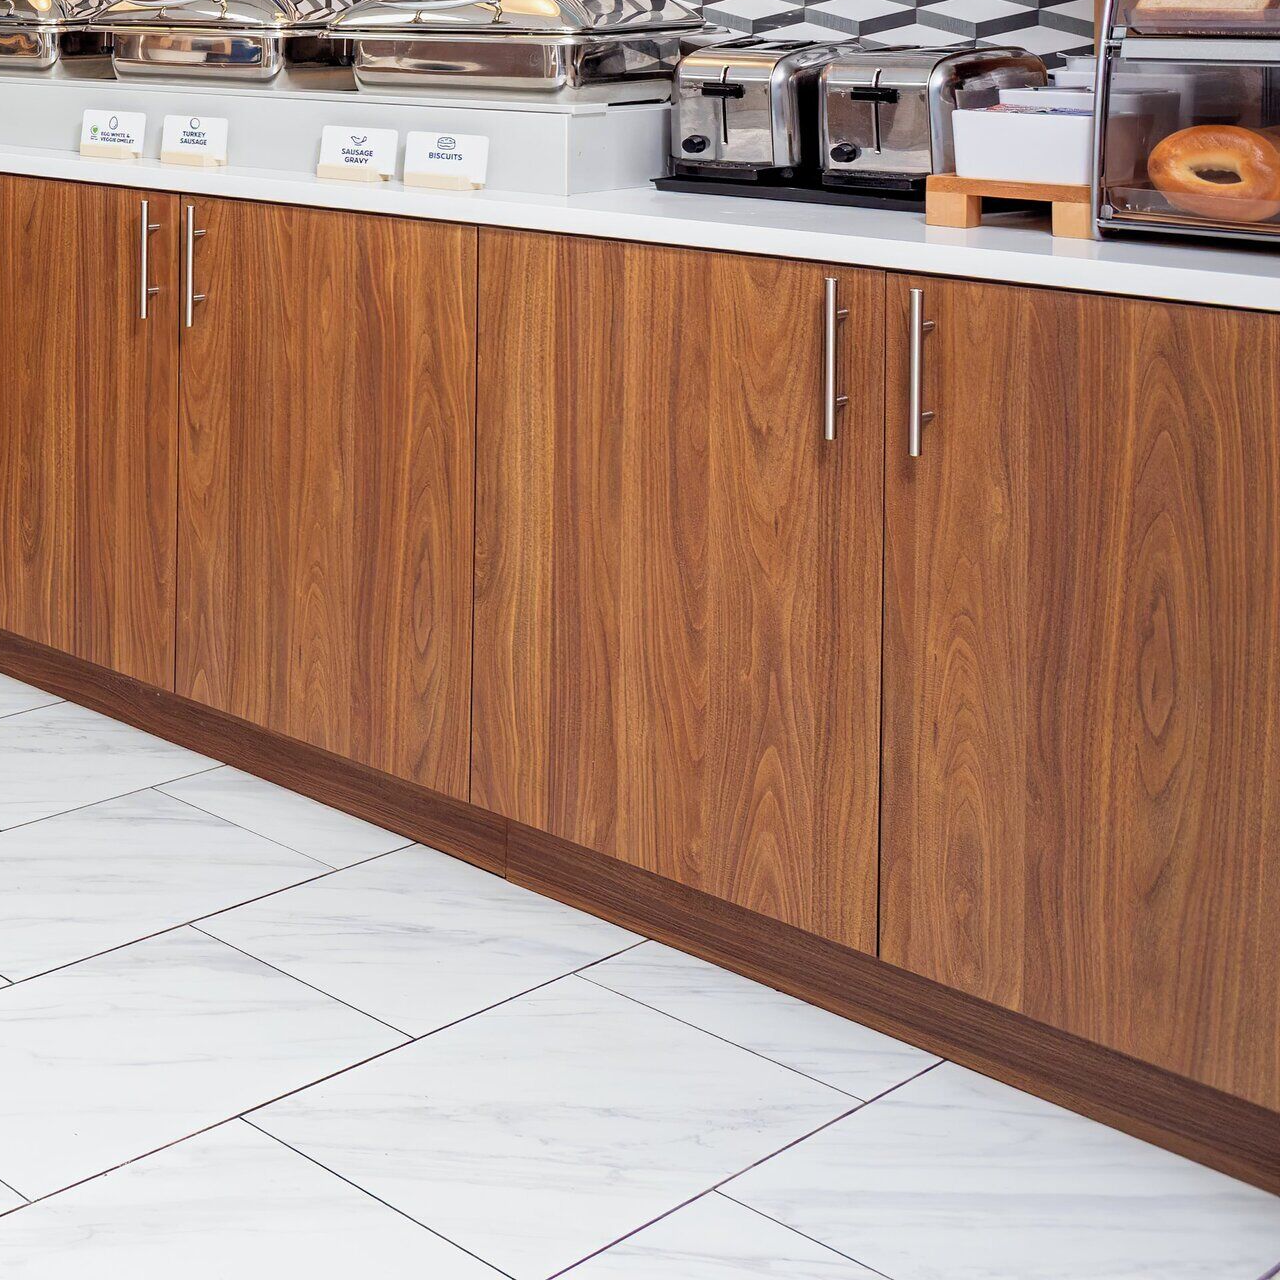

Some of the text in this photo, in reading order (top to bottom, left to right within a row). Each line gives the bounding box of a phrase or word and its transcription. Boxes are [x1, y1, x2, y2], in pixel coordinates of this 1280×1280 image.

[182, 130, 207, 138] TURKEY
[180, 138, 207, 146] SAUSAGE
[341, 147, 374, 157] SAUSAGE
[428, 151, 464, 161] BISCUITS
[344, 156, 370, 164] GRAVY
